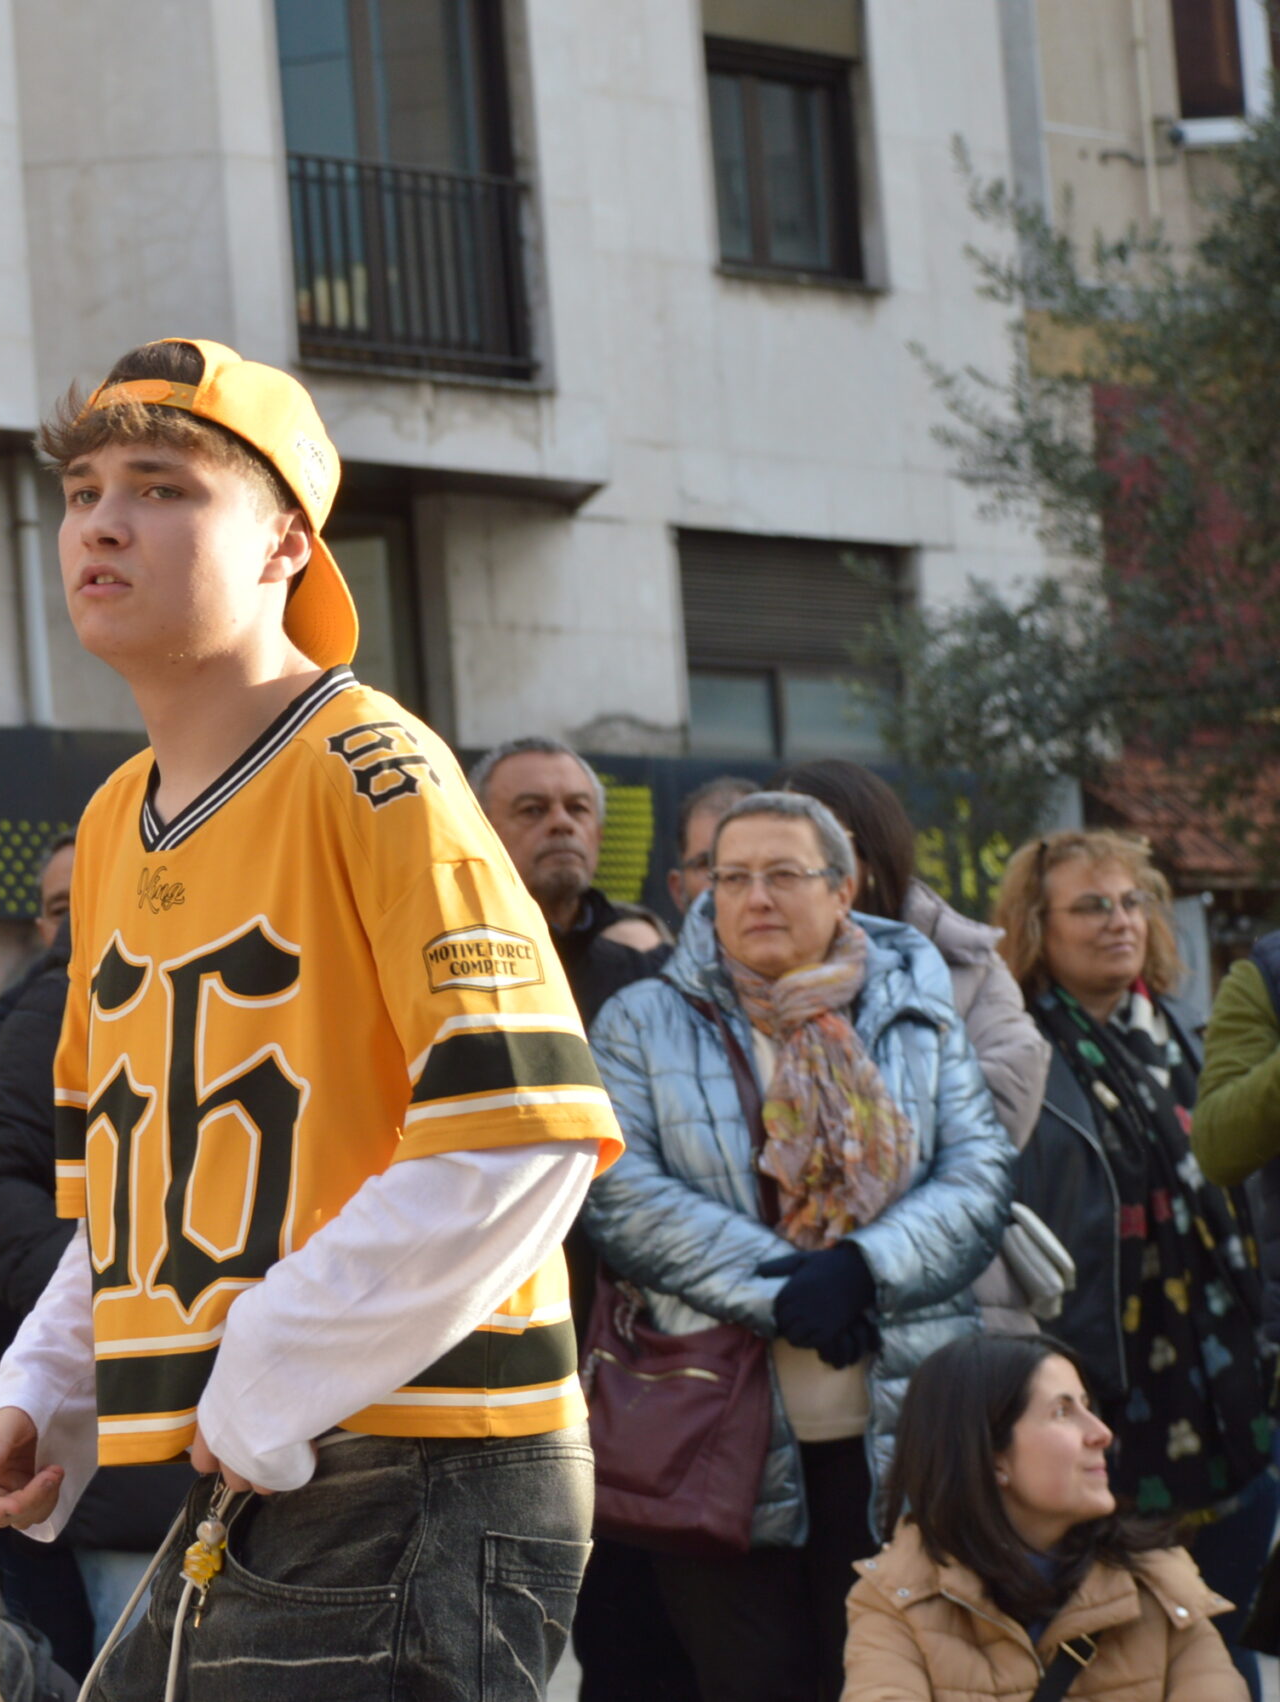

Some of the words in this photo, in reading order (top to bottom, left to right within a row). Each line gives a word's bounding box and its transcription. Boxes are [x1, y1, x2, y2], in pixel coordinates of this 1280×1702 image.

[428, 942, 486, 963] MOTIVE
[488, 942, 533, 960] FORCE
[450, 959, 518, 976] COMPETE
